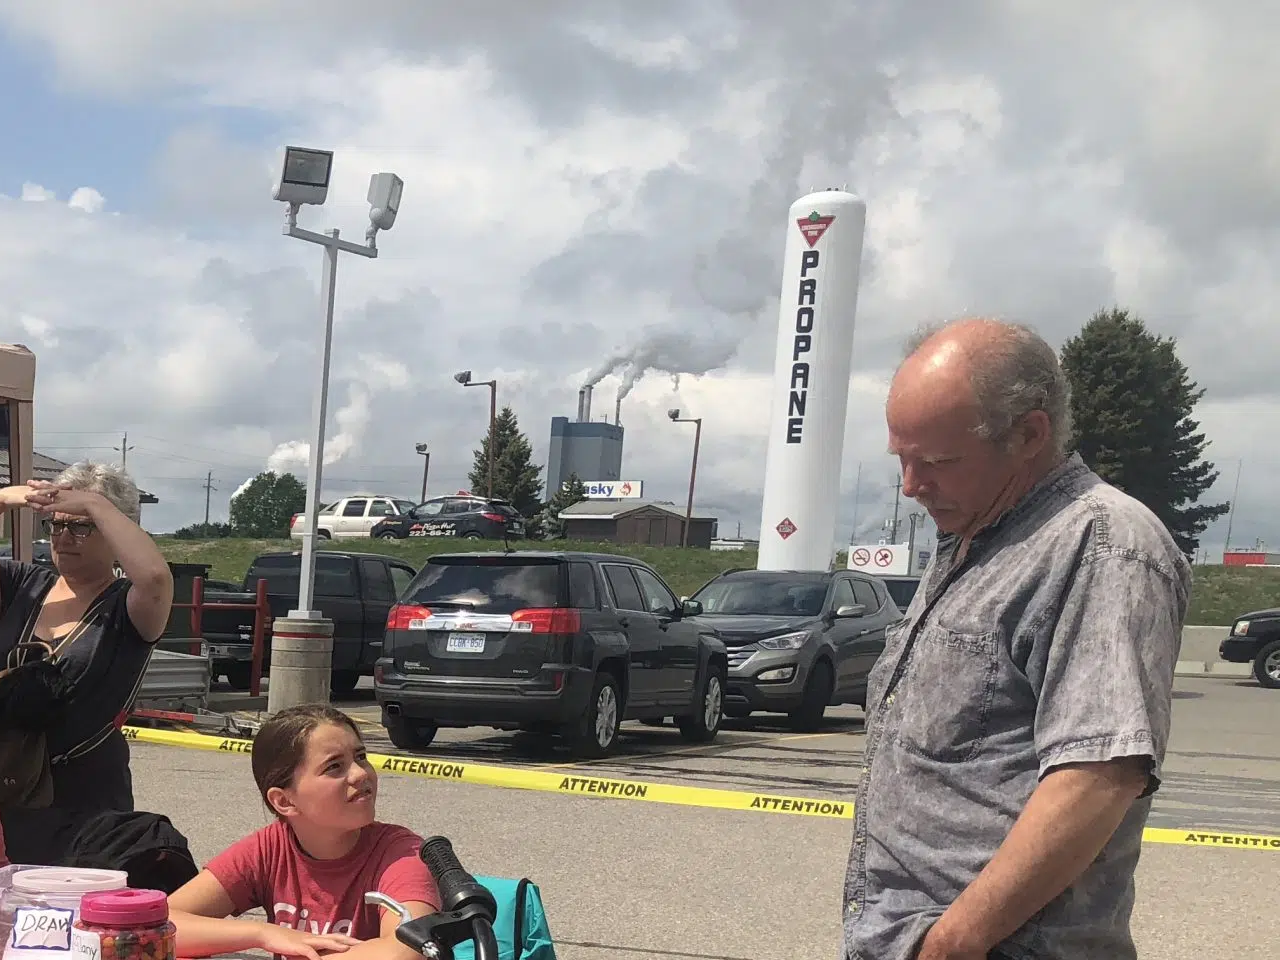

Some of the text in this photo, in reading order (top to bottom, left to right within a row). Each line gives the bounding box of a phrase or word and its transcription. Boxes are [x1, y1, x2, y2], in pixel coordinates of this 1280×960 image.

[786, 250, 819, 443] PROPANE
[381, 758, 464, 779] ATTENTION
[559, 777, 648, 798] ATTENTION
[750, 796, 845, 816] ATTENTION
[1184, 833, 1280, 848] ATTENTIO
